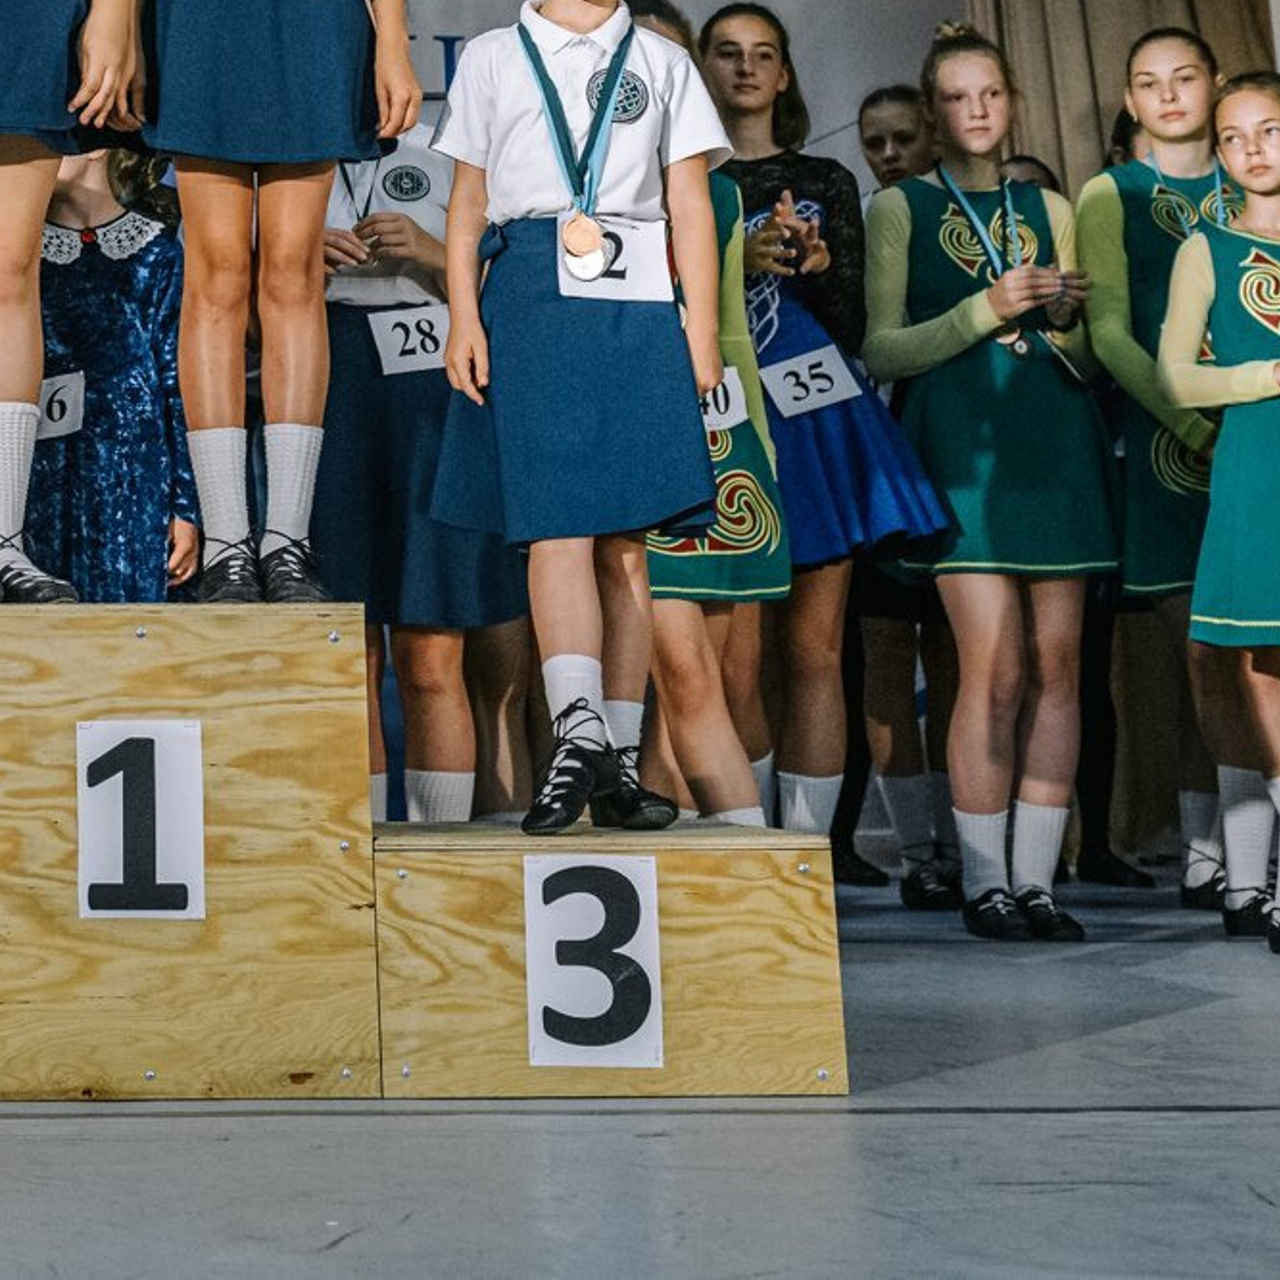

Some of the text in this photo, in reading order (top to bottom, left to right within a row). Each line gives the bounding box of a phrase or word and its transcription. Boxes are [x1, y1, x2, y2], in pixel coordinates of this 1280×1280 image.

[600, 231, 628, 280] 2
[391, 318, 441, 357] 28
[782, 360, 835, 402] 35
[86, 736, 189, 911] 1
[541, 865, 652, 1047] 3
